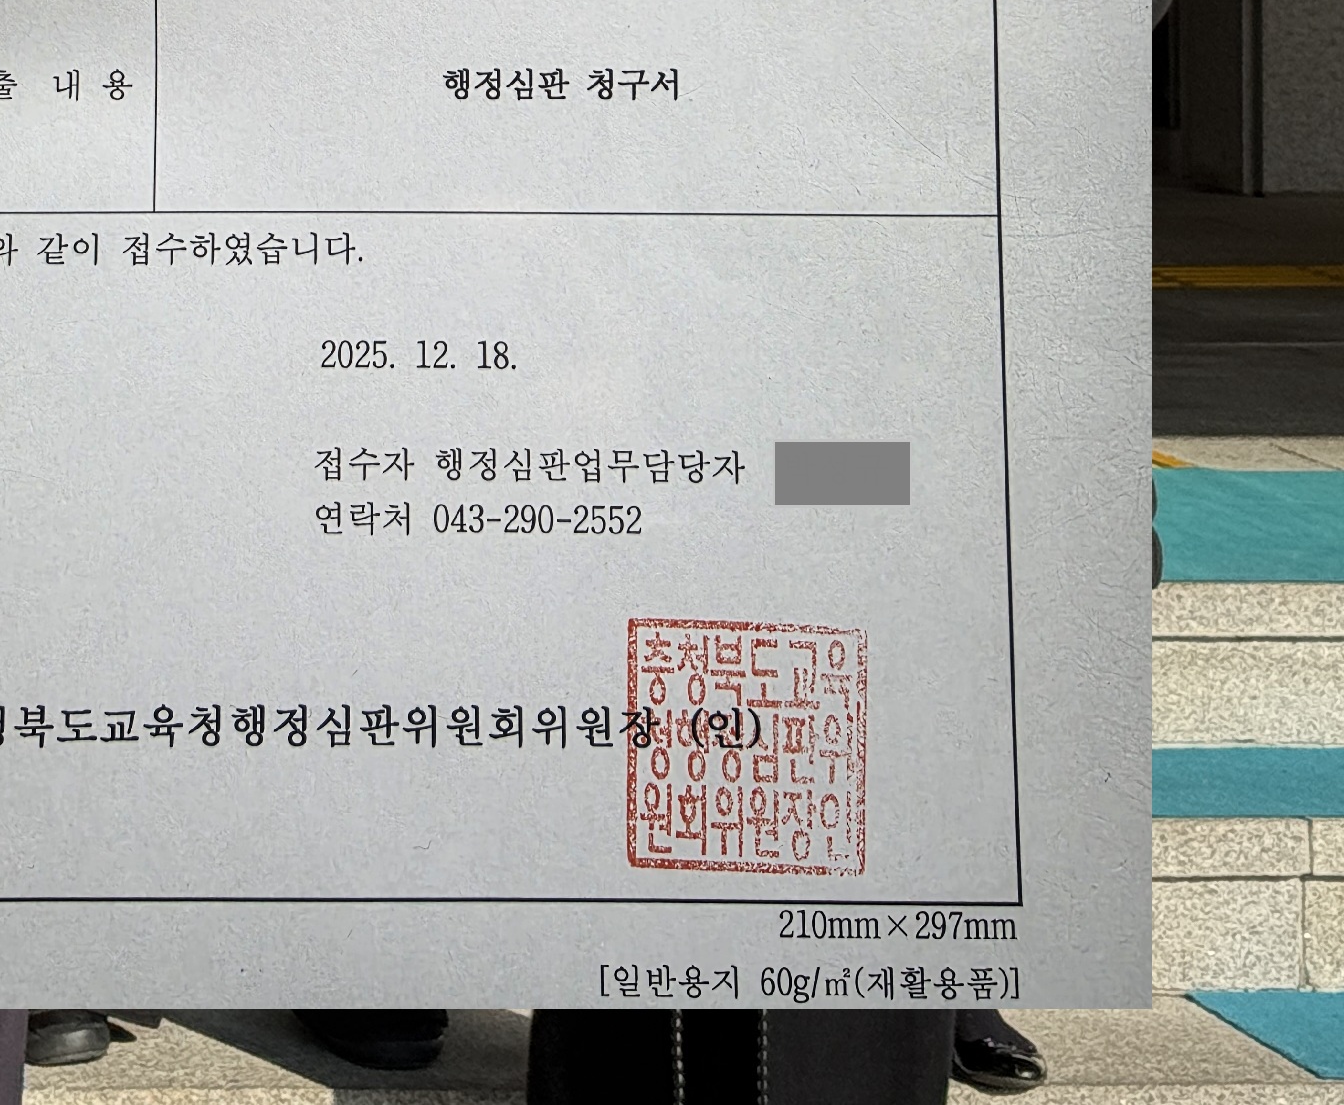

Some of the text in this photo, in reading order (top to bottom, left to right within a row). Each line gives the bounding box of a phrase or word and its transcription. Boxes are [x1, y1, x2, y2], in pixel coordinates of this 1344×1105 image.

[443, 68, 681, 102] 행정심판 청구서
[37, 233, 100, 265] 같이
[123, 233, 363, 265] 접수하였습니다.
[321, 340, 517, 370] 2025. 12. 18.
[315, 447, 745, 485] 접수자 행정심판업무담당자
[315, 502, 642, 536] 연락처 043-290-2552
[691, 708, 763, 750] (인)
[601, 965, 739, 999] [일반용지
